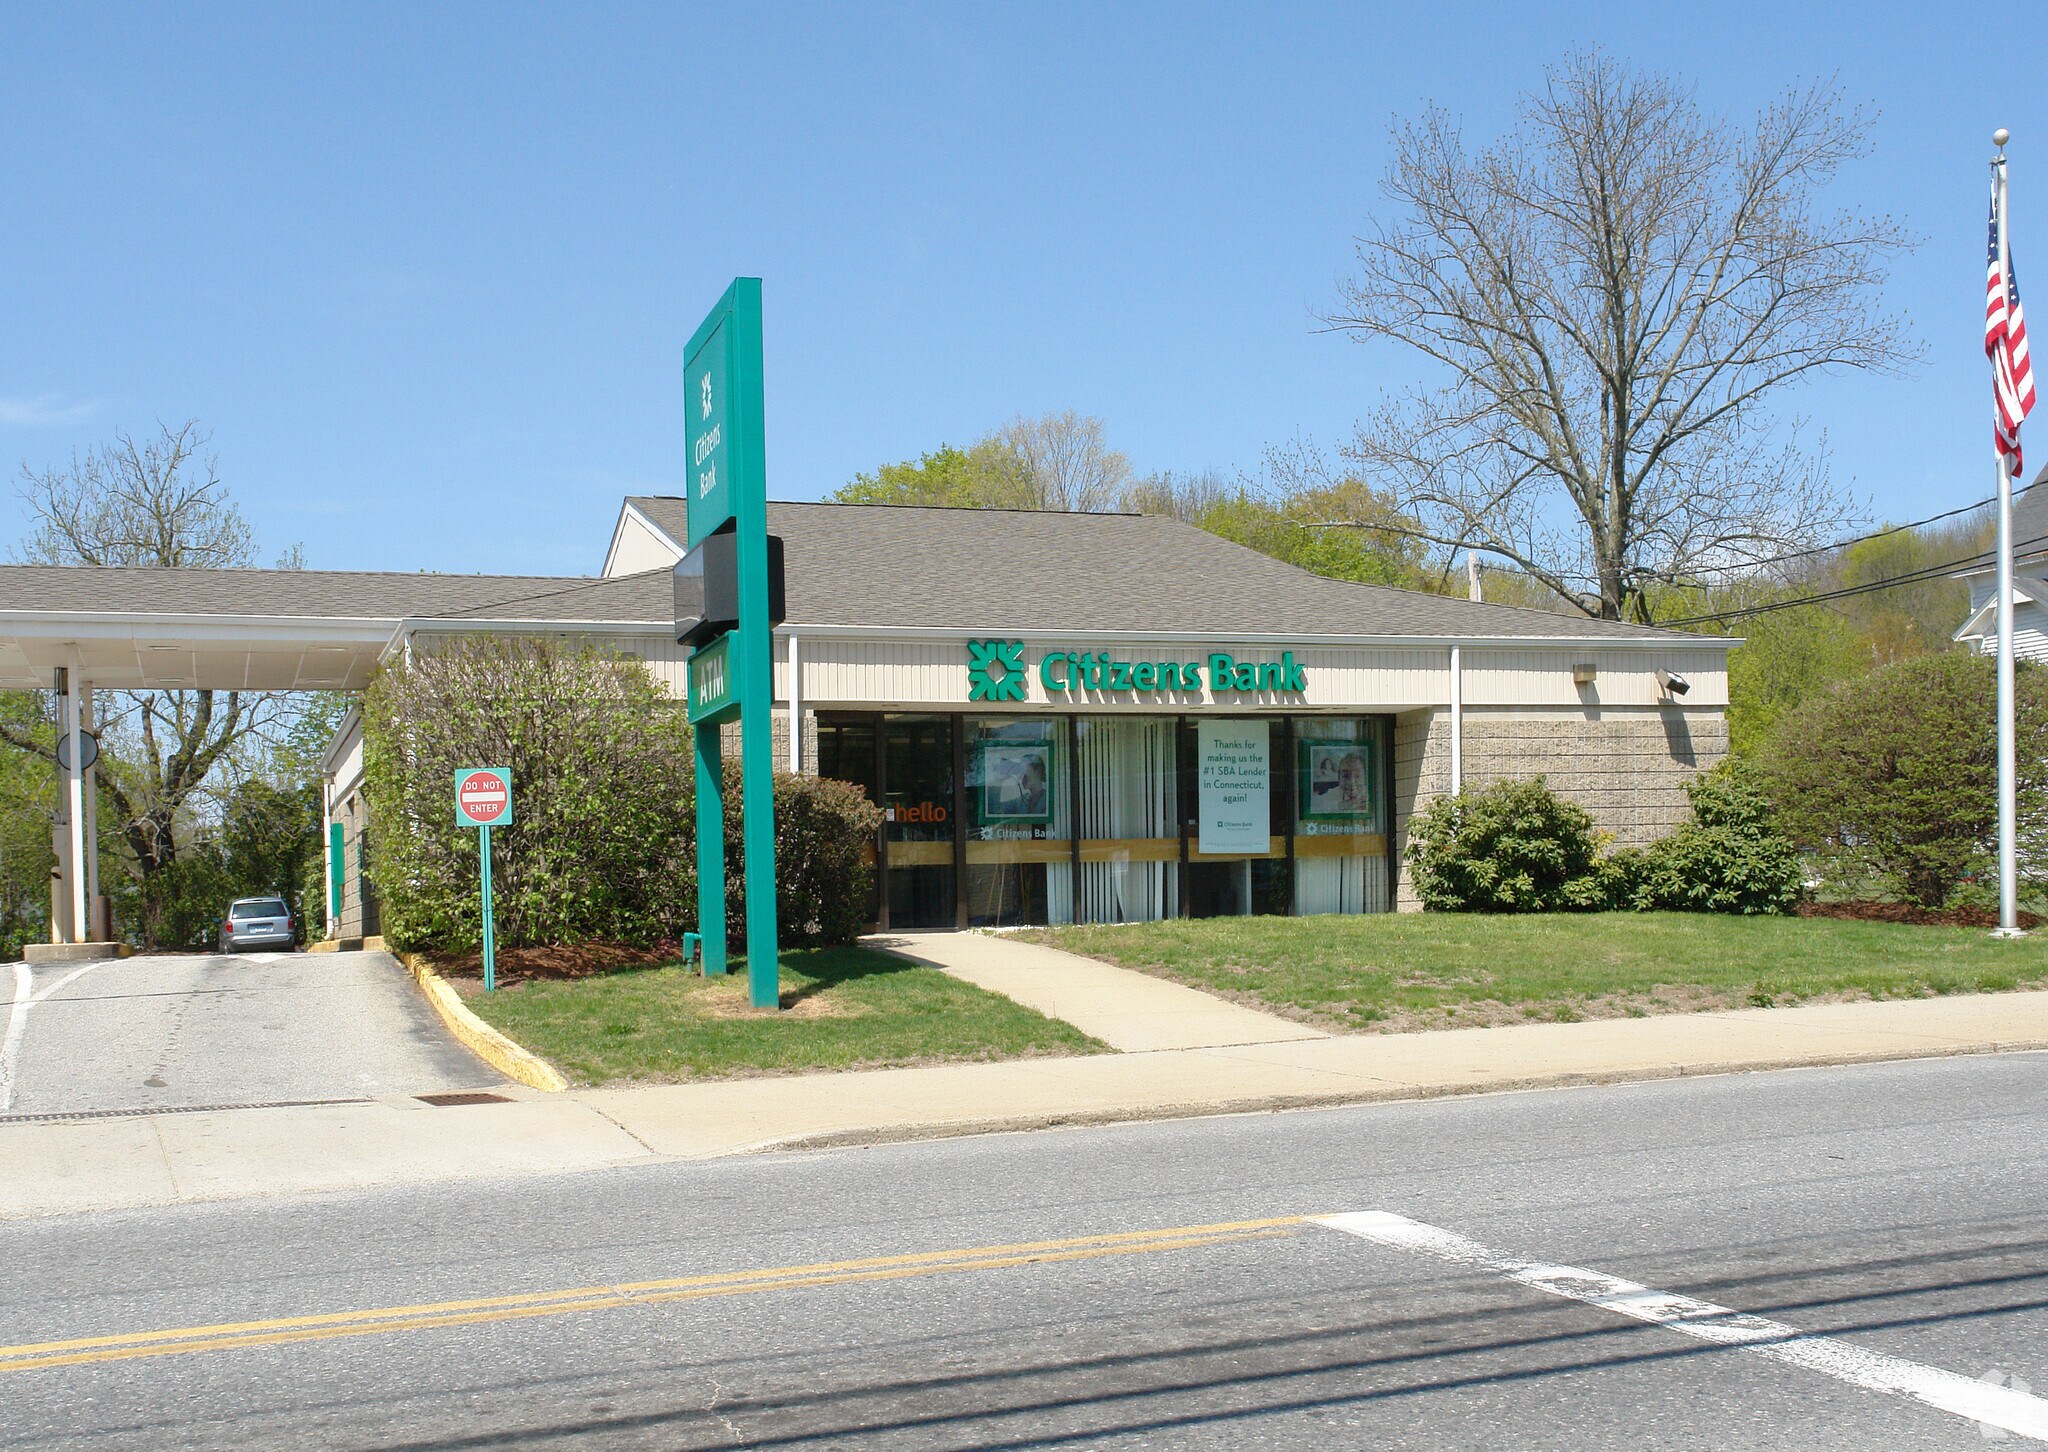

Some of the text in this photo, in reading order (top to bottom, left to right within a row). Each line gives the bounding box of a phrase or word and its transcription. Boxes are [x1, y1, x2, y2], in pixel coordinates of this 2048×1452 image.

[695, 423, 721, 467] Citizens
[700, 460, 717, 500] Bank
[1040, 651, 1306, 692] Citizens Bank
[700, 655, 724, 706] ATM
[1213, 740, 1256, 749] Thanks for
[1207, 753, 1237, 764] making
[1249, 754, 1263, 763] the
[1203, 766, 1267, 775] #1 SBA Lender
[465, 780, 501, 790] DO NOT
[1203, 779, 1265, 790] in Connecticut,
[1222, 793, 1247, 804] again!
[470, 803, 499, 813] ENTER
[895, 801, 947, 822] hello
[996, 828, 1057, 838] Citizens Bank
[1320, 823, 1376, 833] Citizens Bank
